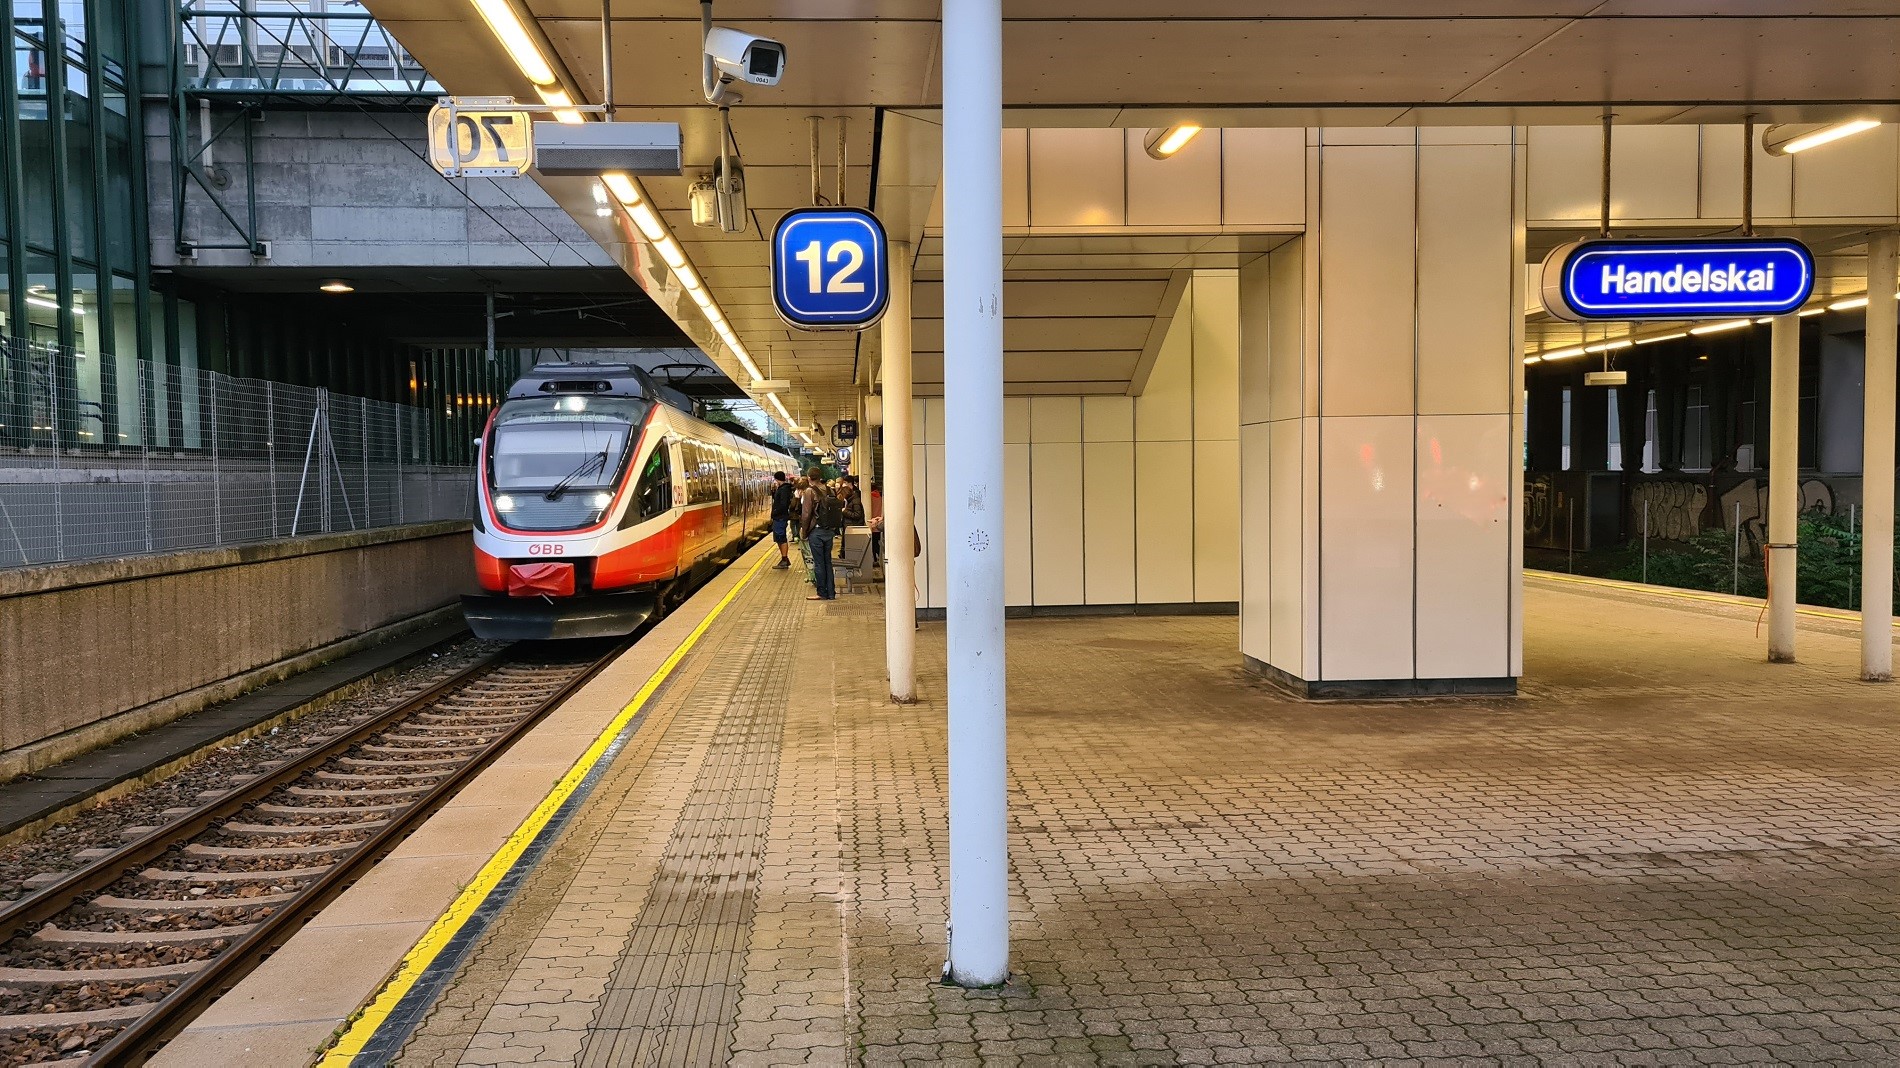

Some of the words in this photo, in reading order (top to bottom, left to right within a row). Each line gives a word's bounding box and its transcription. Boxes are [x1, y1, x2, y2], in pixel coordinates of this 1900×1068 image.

[755, 76, 769, 84] 0043
[795, 240, 865, 294] 12
[1601, 262, 1775, 295] Handelskai
[838, 451, 848, 460] U
[529, 543, 564, 555] ÖBB
